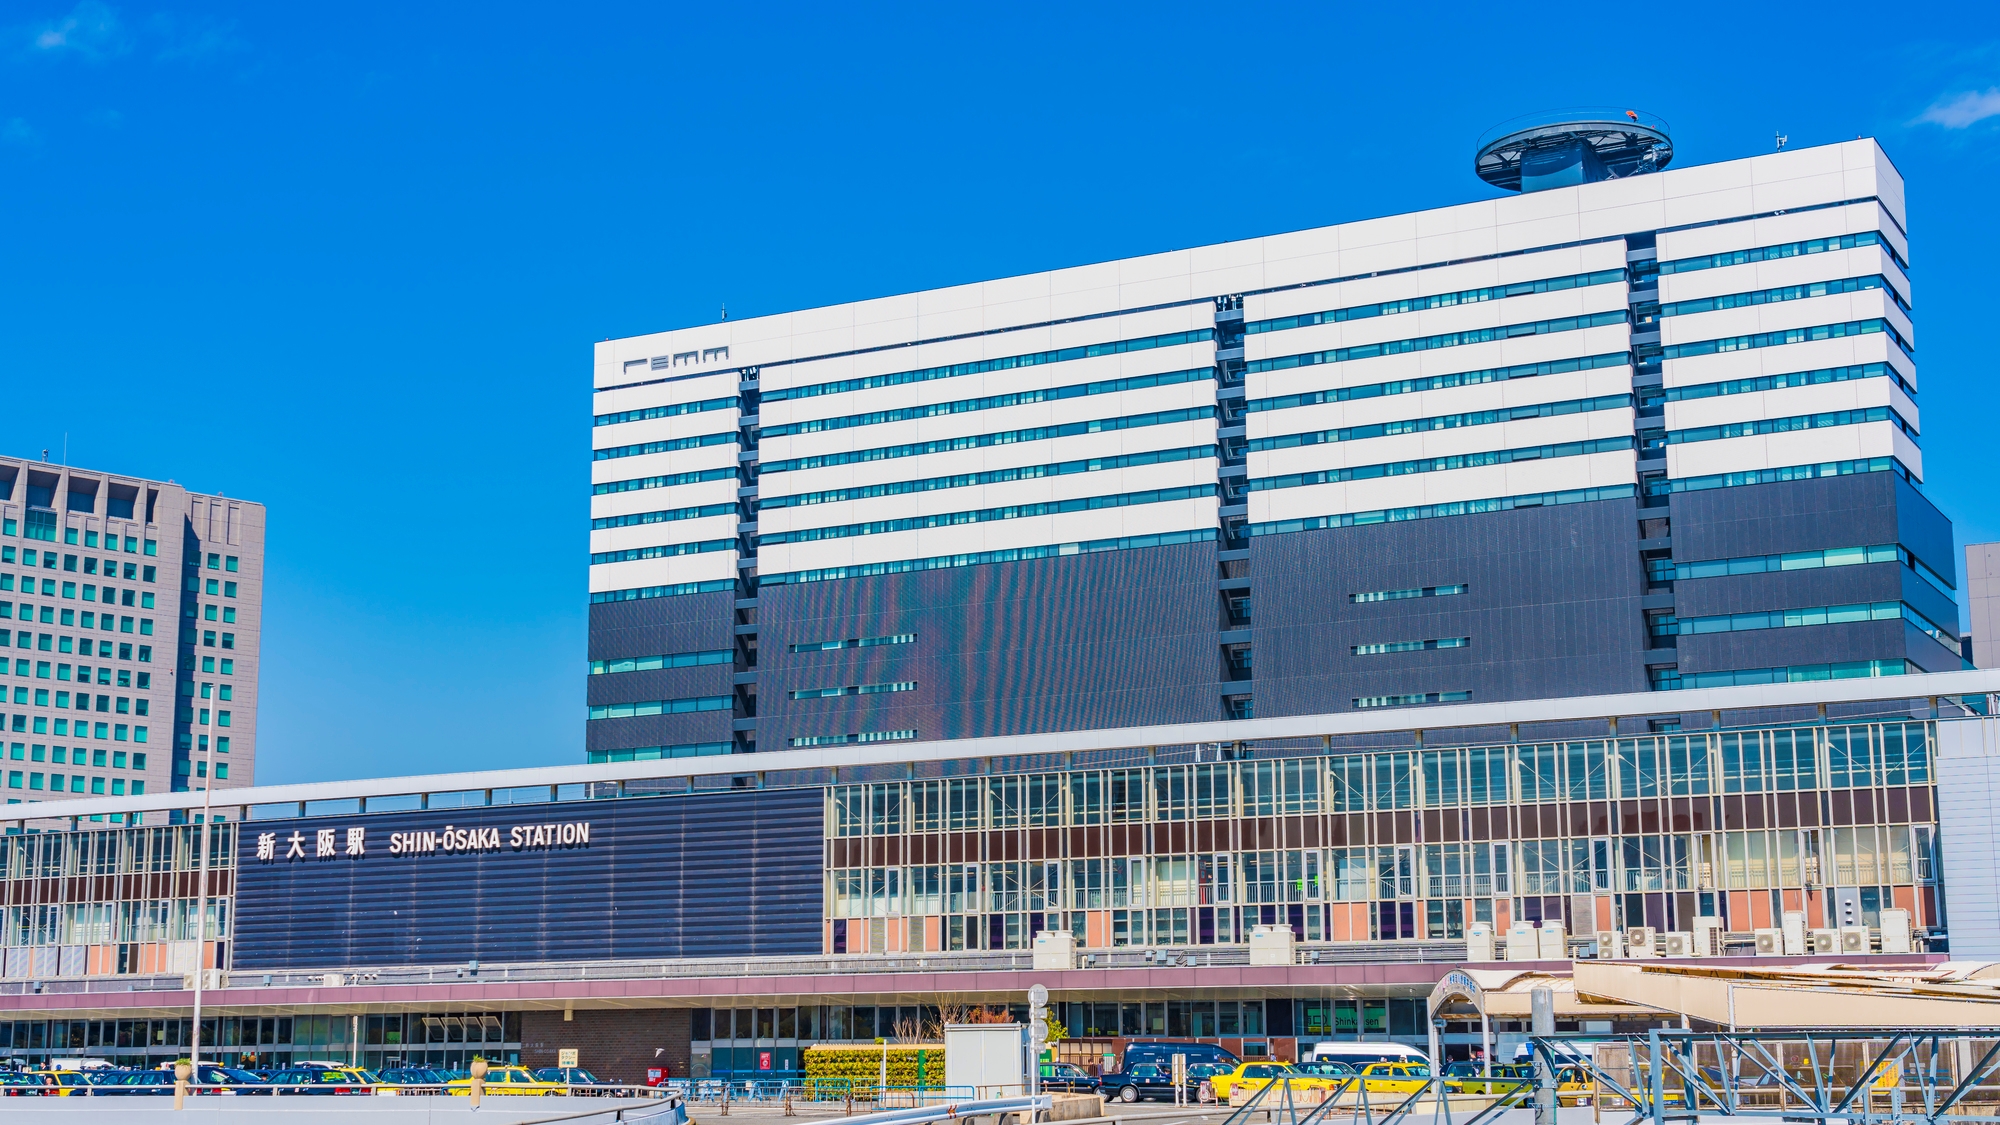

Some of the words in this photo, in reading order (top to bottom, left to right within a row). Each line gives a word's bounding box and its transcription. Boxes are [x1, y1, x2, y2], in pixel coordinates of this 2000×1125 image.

[623, 346, 729, 375] remm
[256, 827, 366, 860] 新大阪駅
[389, 825, 501, 853] SHIN-ŌSAKA
[510, 822, 590, 847] STATION
[1335, 1016, 1379, 1026] Shinksen
